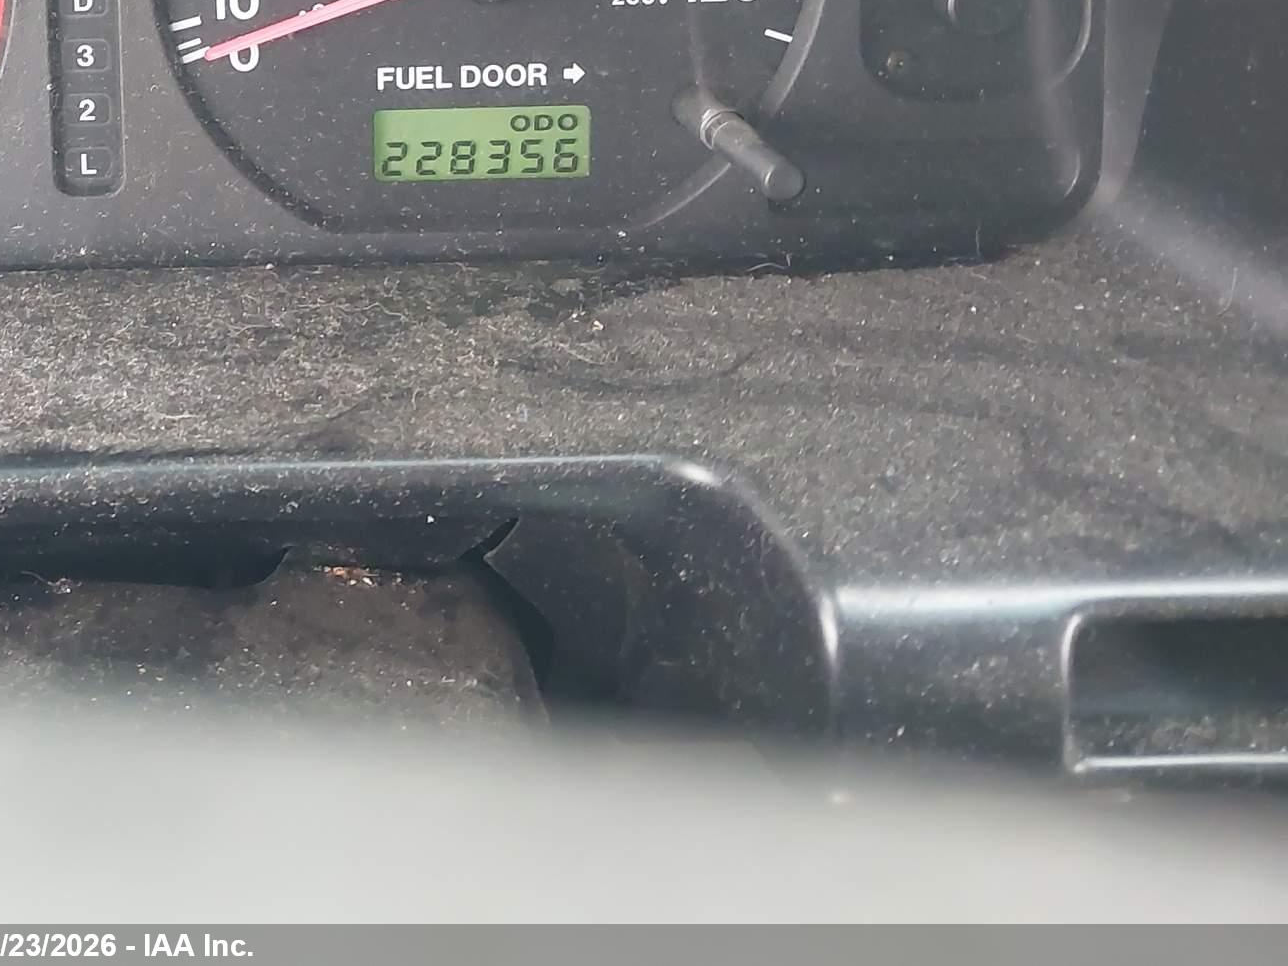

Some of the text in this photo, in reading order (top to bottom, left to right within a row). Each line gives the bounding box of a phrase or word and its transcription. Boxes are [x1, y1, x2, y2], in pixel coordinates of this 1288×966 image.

[76, 44, 95, 67] 3
[229, 43, 260, 72] 0
[377, 63, 548, 91] FUEL DOOR
[79, 98, 96, 121] 2
[510, 113, 579, 133] ODO
[80, 153, 98, 175] L
[381, 138, 579, 176] 228356
